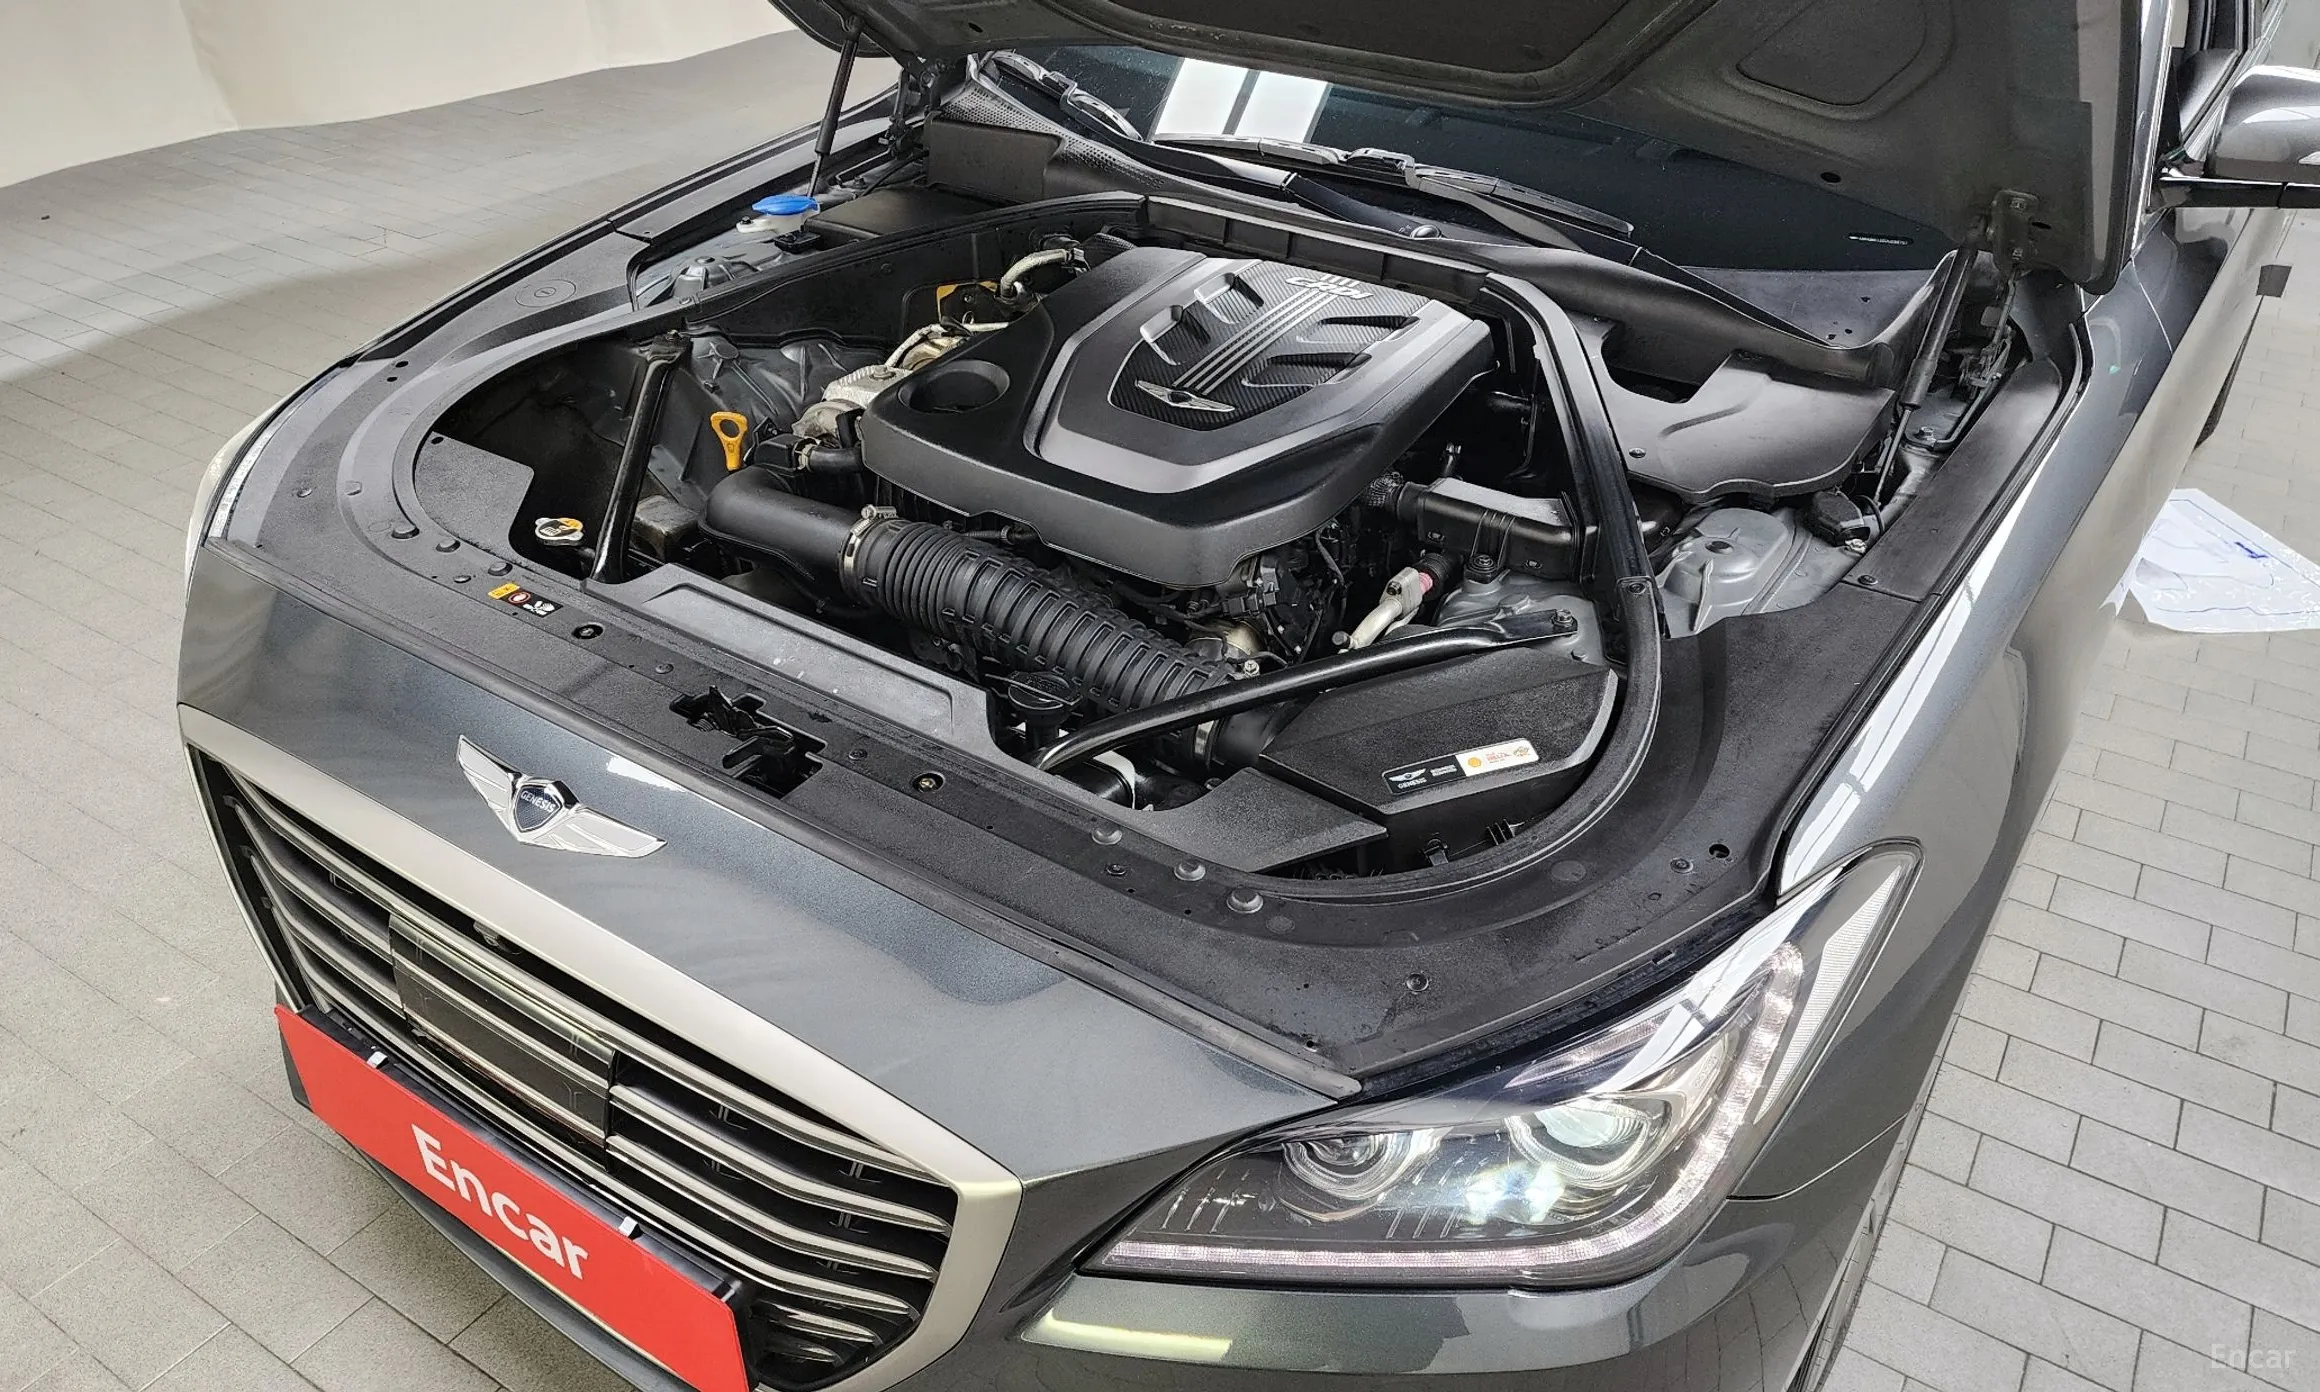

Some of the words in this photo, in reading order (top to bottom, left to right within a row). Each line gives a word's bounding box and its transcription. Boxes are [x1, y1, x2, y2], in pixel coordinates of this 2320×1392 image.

[1398, 777, 1427, 789] GENESIS
[520, 790, 555, 812] GENESIS
[411, 1123, 588, 1281] Encar
